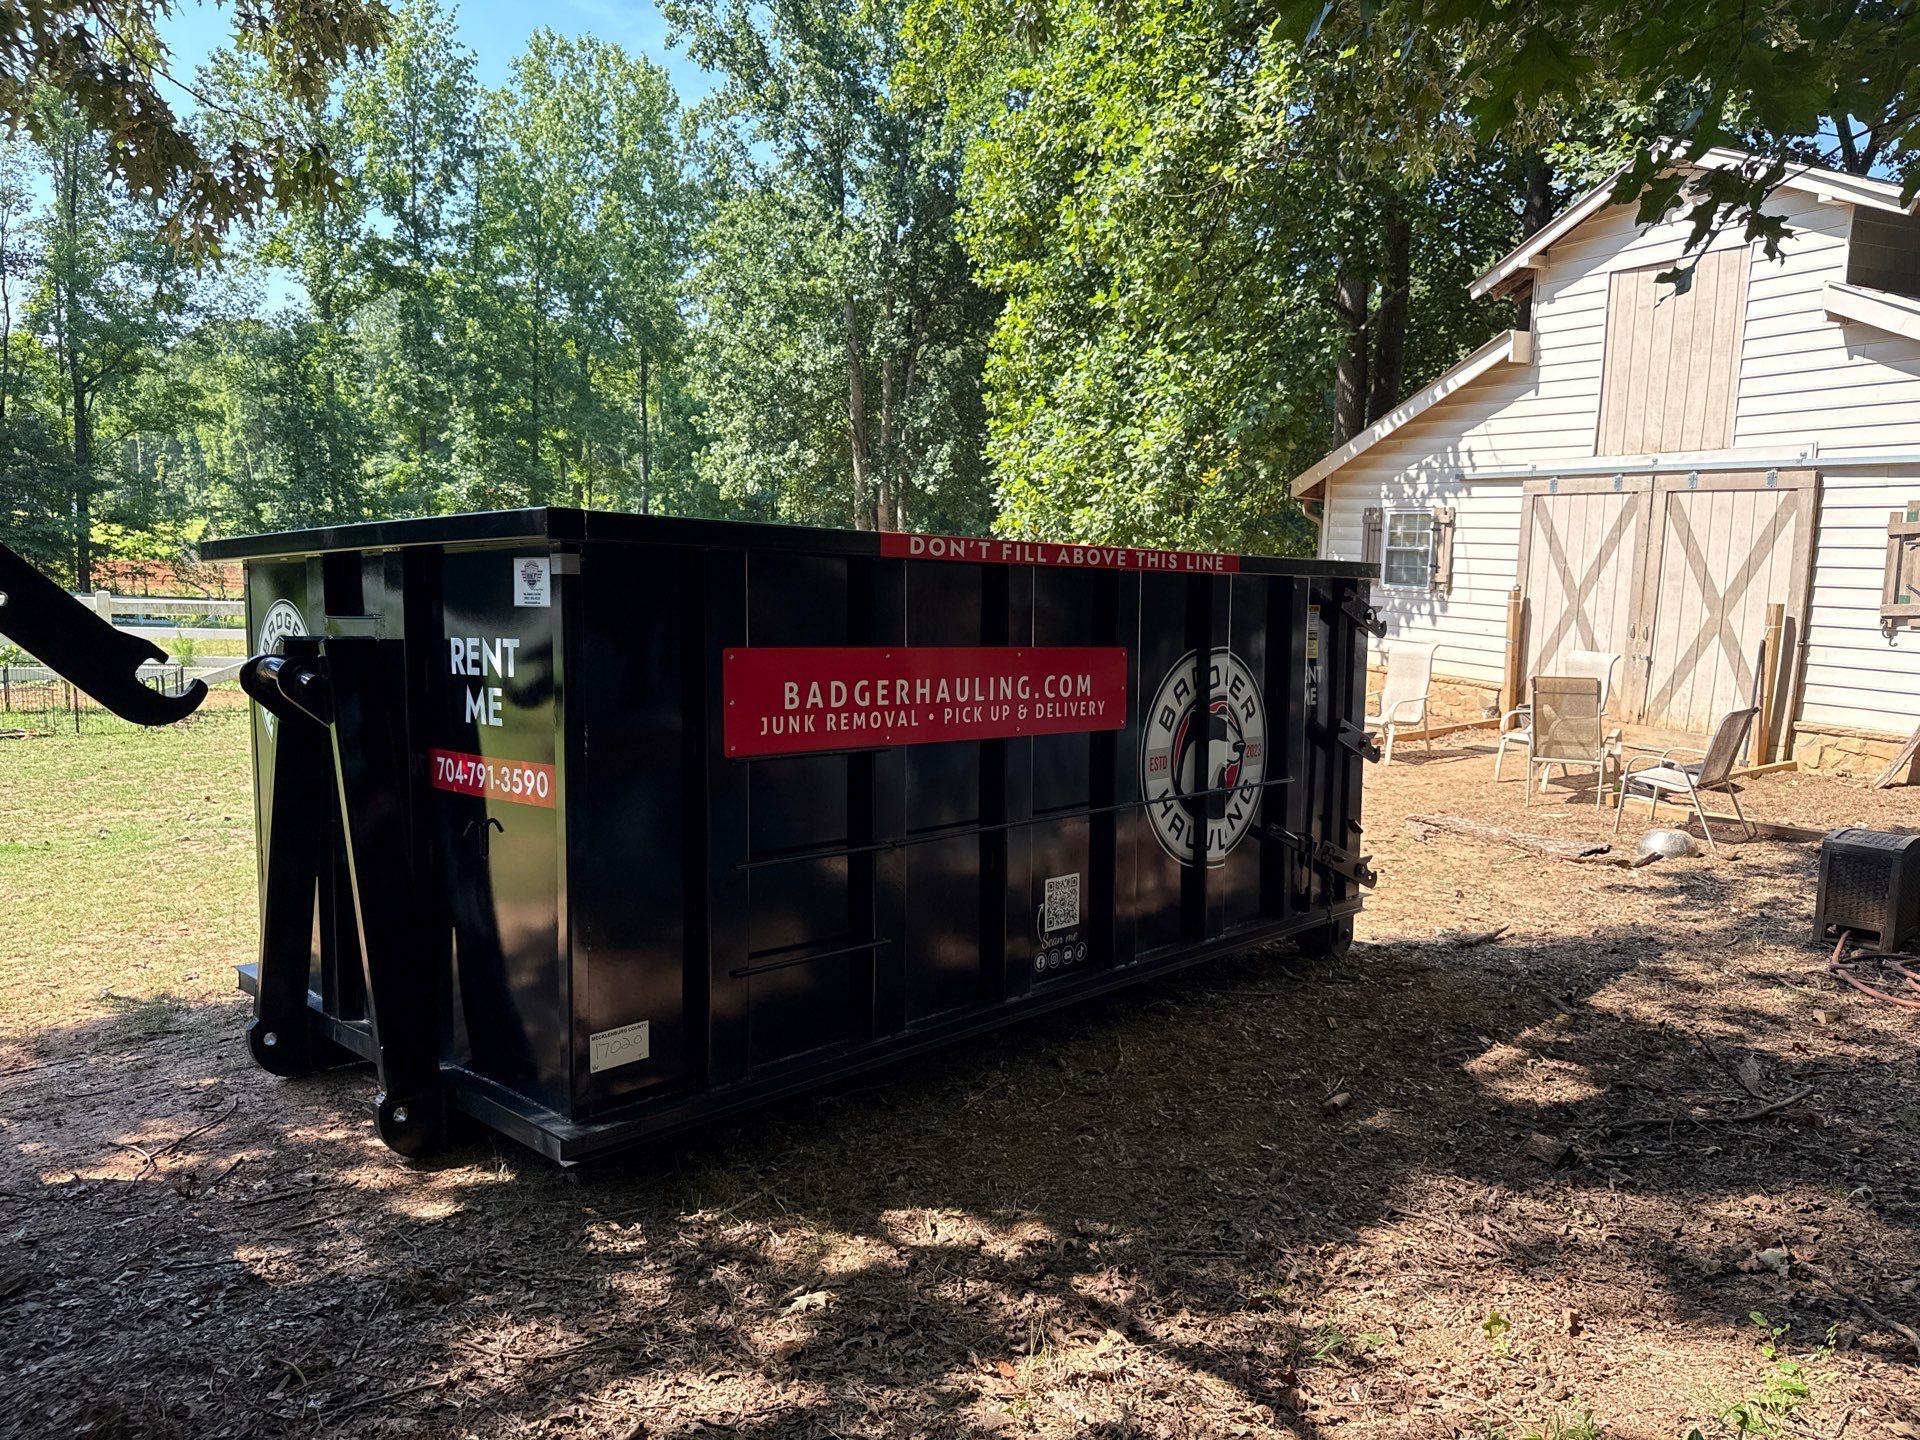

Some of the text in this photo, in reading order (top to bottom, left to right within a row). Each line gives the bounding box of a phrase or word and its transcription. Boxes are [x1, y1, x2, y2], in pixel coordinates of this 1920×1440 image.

[910, 536, 1224, 571] DON'T FILL ABOVE THIS LINE
[263, 612, 301, 655] BADGE
[450, 637, 520, 678] RENT
[465, 685, 503, 727] ME
[784, 674, 1092, 710] BADGERHAULING.COM
[1159, 665, 1256, 733] BADER
[760, 700, 1106, 736] JUNK REMOVAL PICK UP & DELIVERY
[436, 756, 549, 799] 704-791-3590
[1150, 755, 1168, 772] ESTD
[1041, 931, 1078, 950] Scan me
[591, 1023, 647, 1042] MECKLENBURG COUNTY
